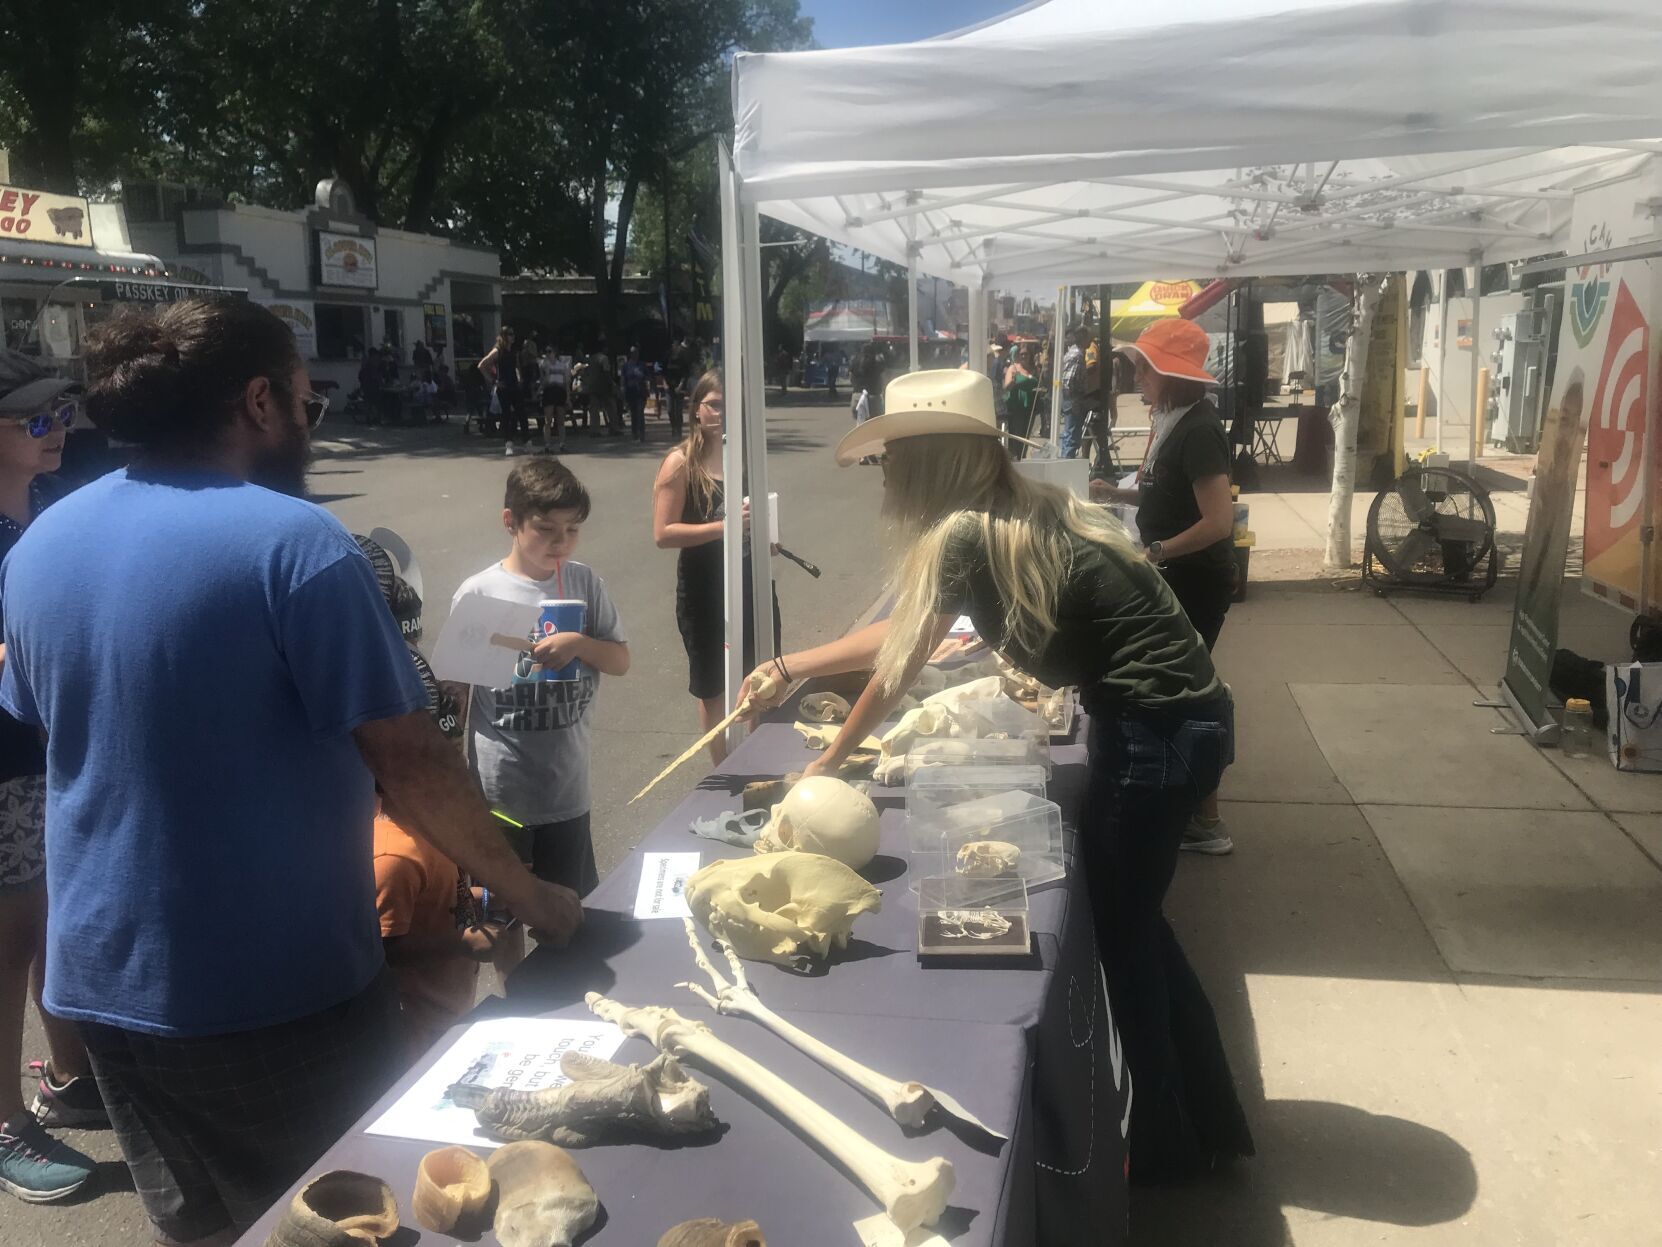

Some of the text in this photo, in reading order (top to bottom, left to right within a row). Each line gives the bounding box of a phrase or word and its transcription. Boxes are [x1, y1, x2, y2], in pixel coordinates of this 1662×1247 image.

[0, 190, 40, 216] EY
[115, 282, 170, 300] PASSKEY
[174, 287, 189, 299] ON
[439, 714, 456, 732] GO
[578, 1034, 604, 1053] You
[502, 1053, 540, 1089] be gen
[524, 1071, 551, 1088] but
